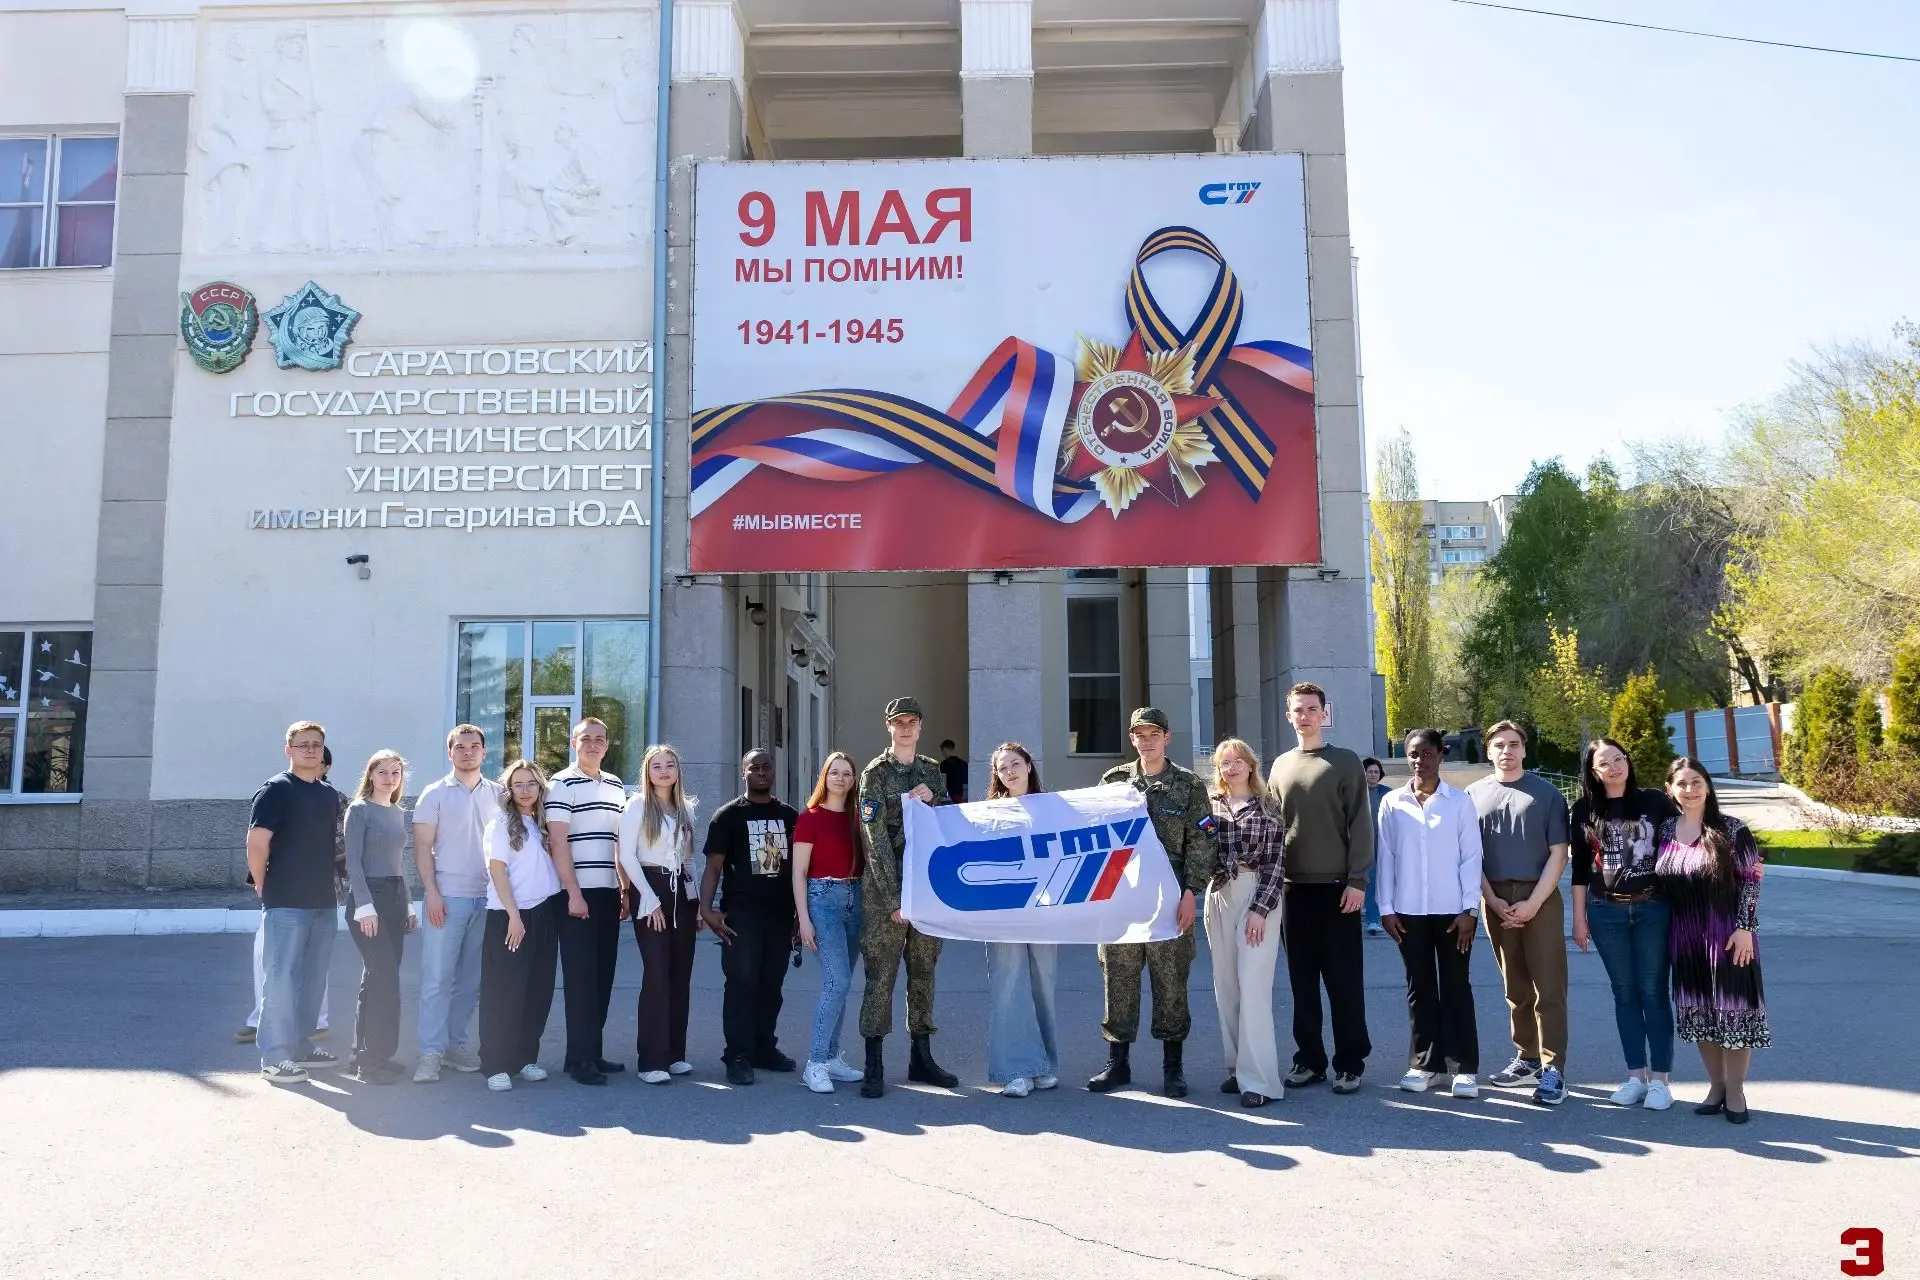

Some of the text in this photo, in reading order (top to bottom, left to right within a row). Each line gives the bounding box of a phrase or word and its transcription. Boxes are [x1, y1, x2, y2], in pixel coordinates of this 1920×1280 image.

[738, 187, 972, 247] 9 МАЯ
[735, 255, 963, 283] МЫ ПОМНИМ!
[200, 288, 240, 302] СССР
[737, 318, 905, 345] 1941-1945
[347, 342, 654, 377] САРАТОВСКИЙ
[229, 383, 654, 418] ГОСУДАРСТВЕННЫЙ
[1081, 374, 1169, 456] ОТЕЧЕСТВЕННАЯ
[345, 420, 652, 455] ТЕХНИЧЕСКИЙ
[345, 464, 652, 493] УНИВЕРСИТЕТ
[249, 499, 651, 533] имени Гагарина Ю.А.
[732, 513, 862, 531] #МЫВМЕСТЕ
